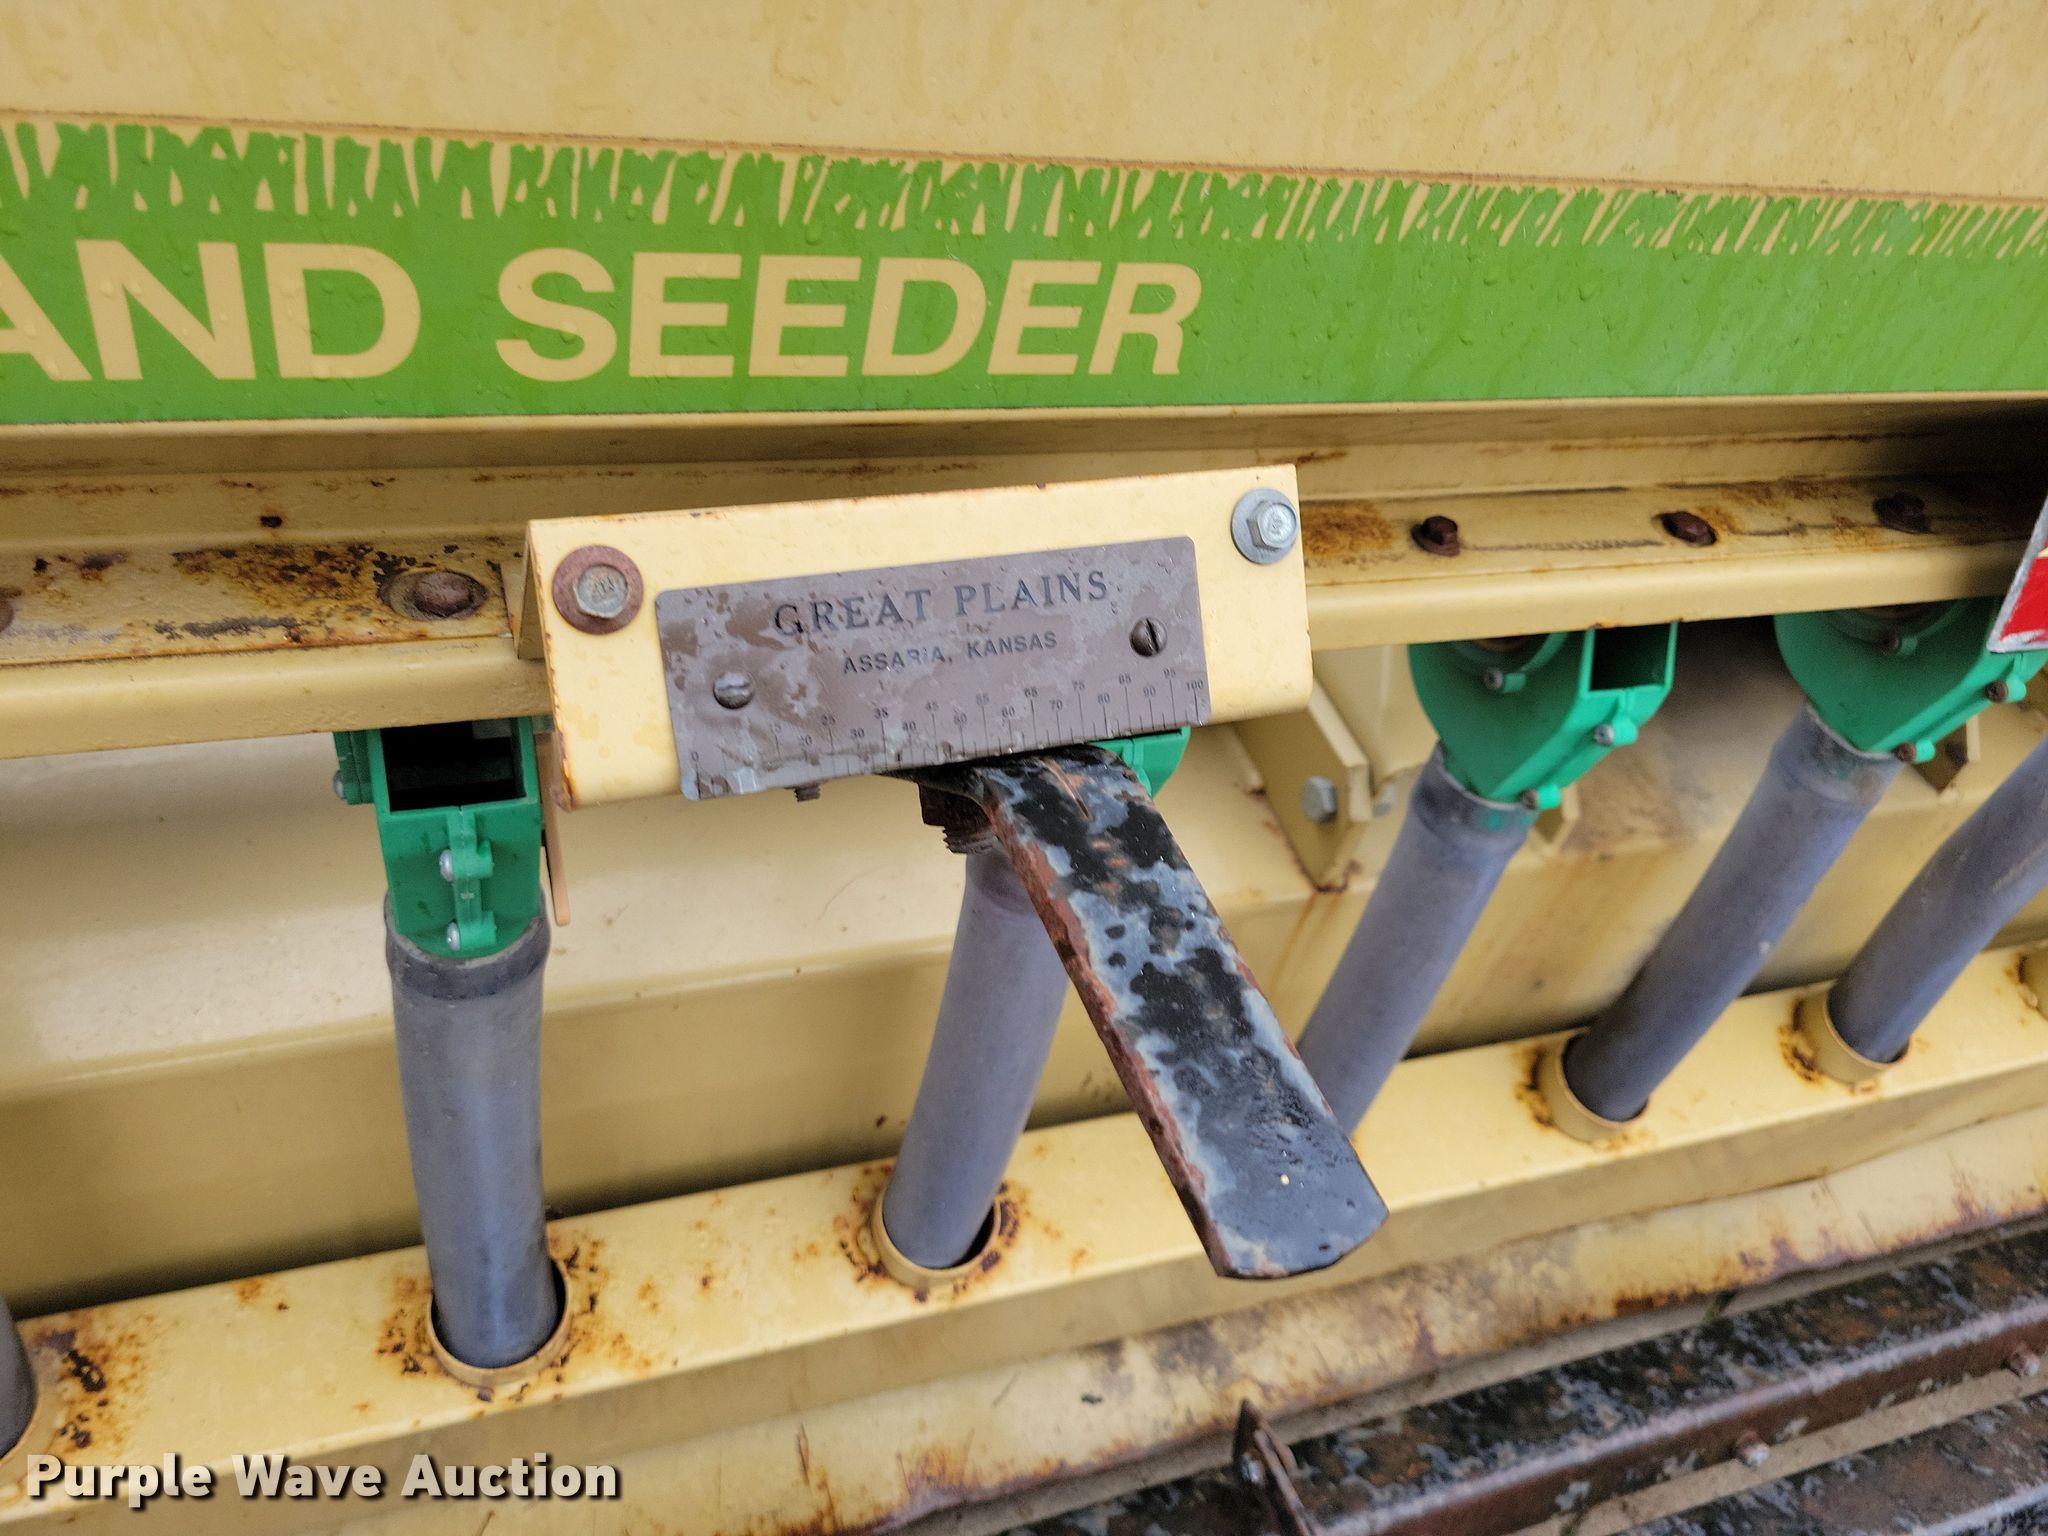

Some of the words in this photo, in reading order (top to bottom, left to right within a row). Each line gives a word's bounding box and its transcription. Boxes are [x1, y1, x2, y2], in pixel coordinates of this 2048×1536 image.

[495, 247, 1202, 382] SEEDER
[773, 589, 931, 637] GREAT
[954, 570, 1108, 617] PLAINS
[842, 645, 954, 675] ASSARIA,
[967, 630, 1058, 659] KANSAS
[851, 727, 865, 739] 30
[902, 720, 916, 731] 40
[1001, 705, 1015, 718] 60
[1048, 699, 1063, 711] 70
[1143, 686, 1156, 698] 90
[1186, 679, 1204, 691] 100
[874, 706, 890, 720] 35
[925, 701, 939, 712] 45
[1023, 686, 1039, 698] 65
[1072, 680, 1085, 691] 75
[1118, 672, 1132, 684] 85
[1163, 667, 1177, 679] 95
